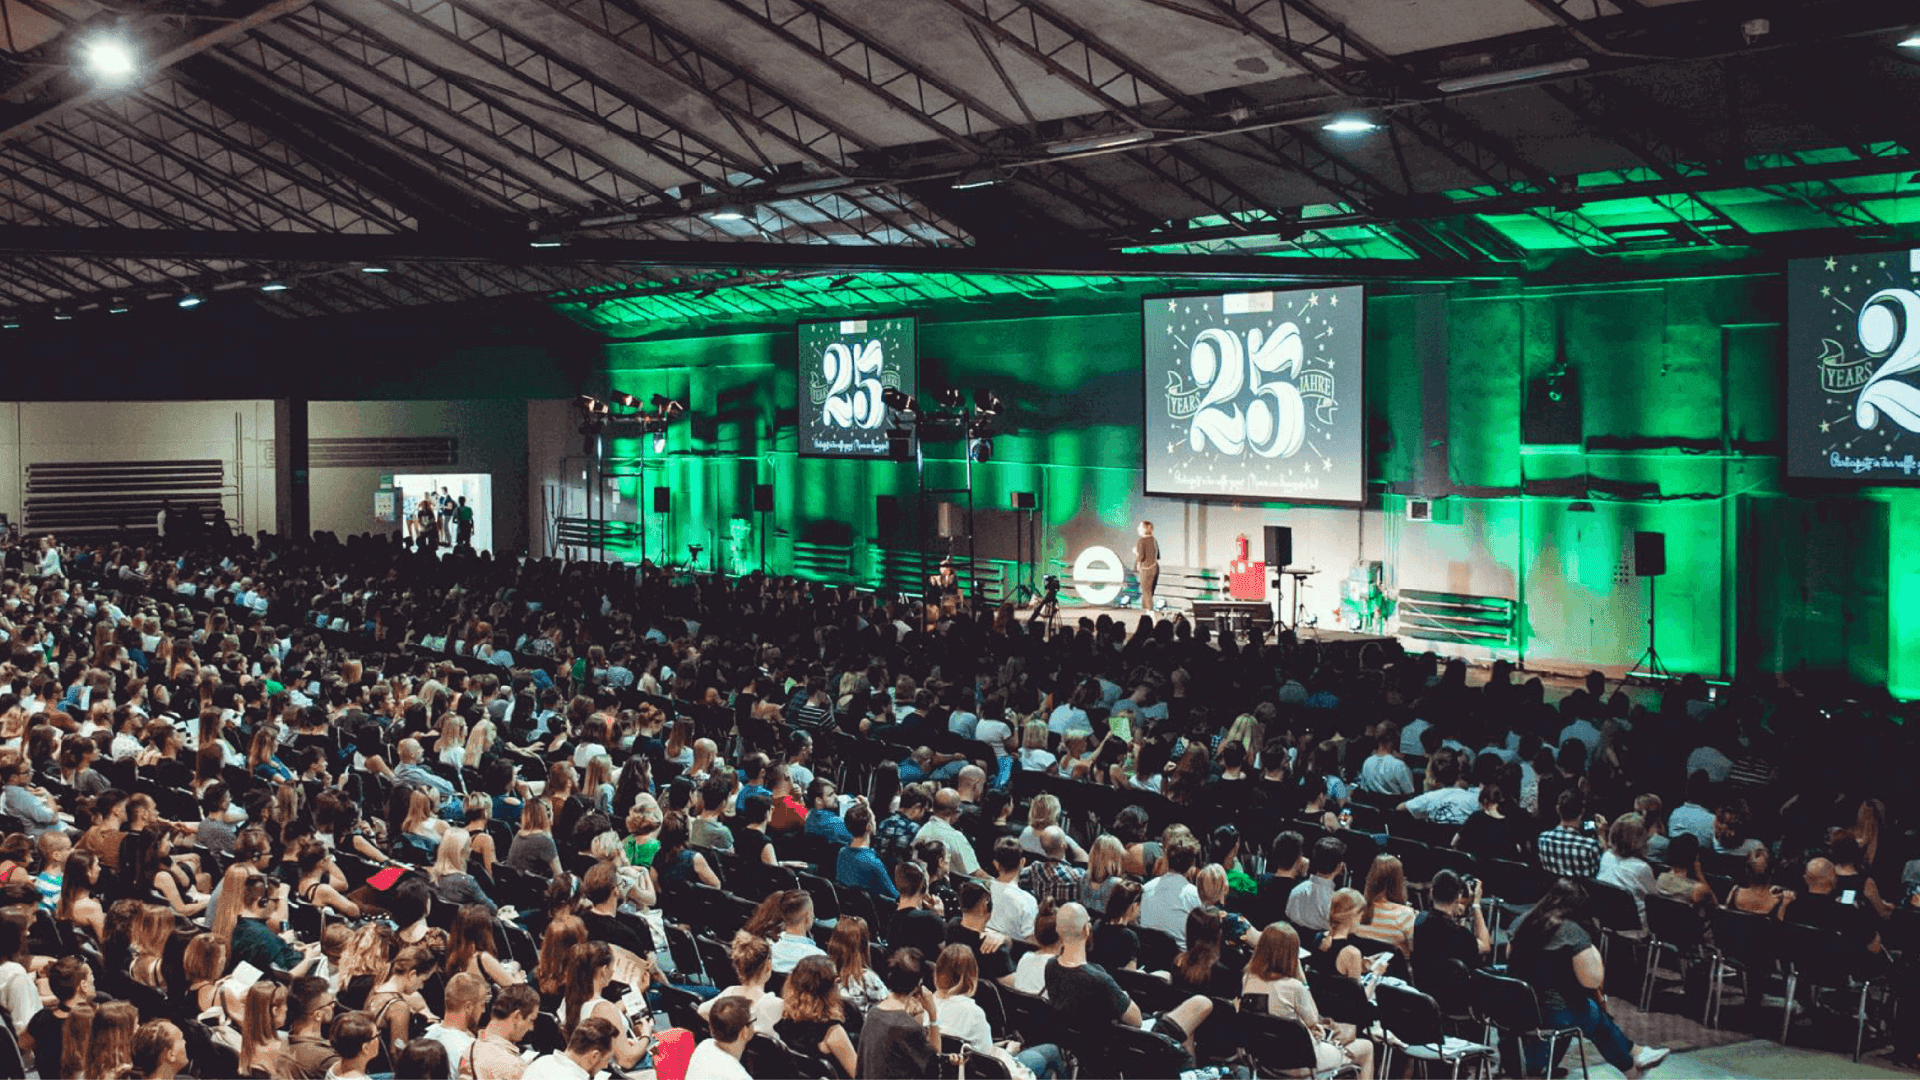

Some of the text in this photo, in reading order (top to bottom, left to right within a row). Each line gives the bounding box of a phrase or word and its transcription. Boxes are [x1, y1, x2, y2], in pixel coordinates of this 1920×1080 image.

[822, 339, 886, 429] 25
[1300, 374, 1331, 396] JAHRE
[1826, 361, 1873, 387] YEARS
[1170, 392, 1200, 414] YEARS
[1190, 322, 1305, 458] 25
